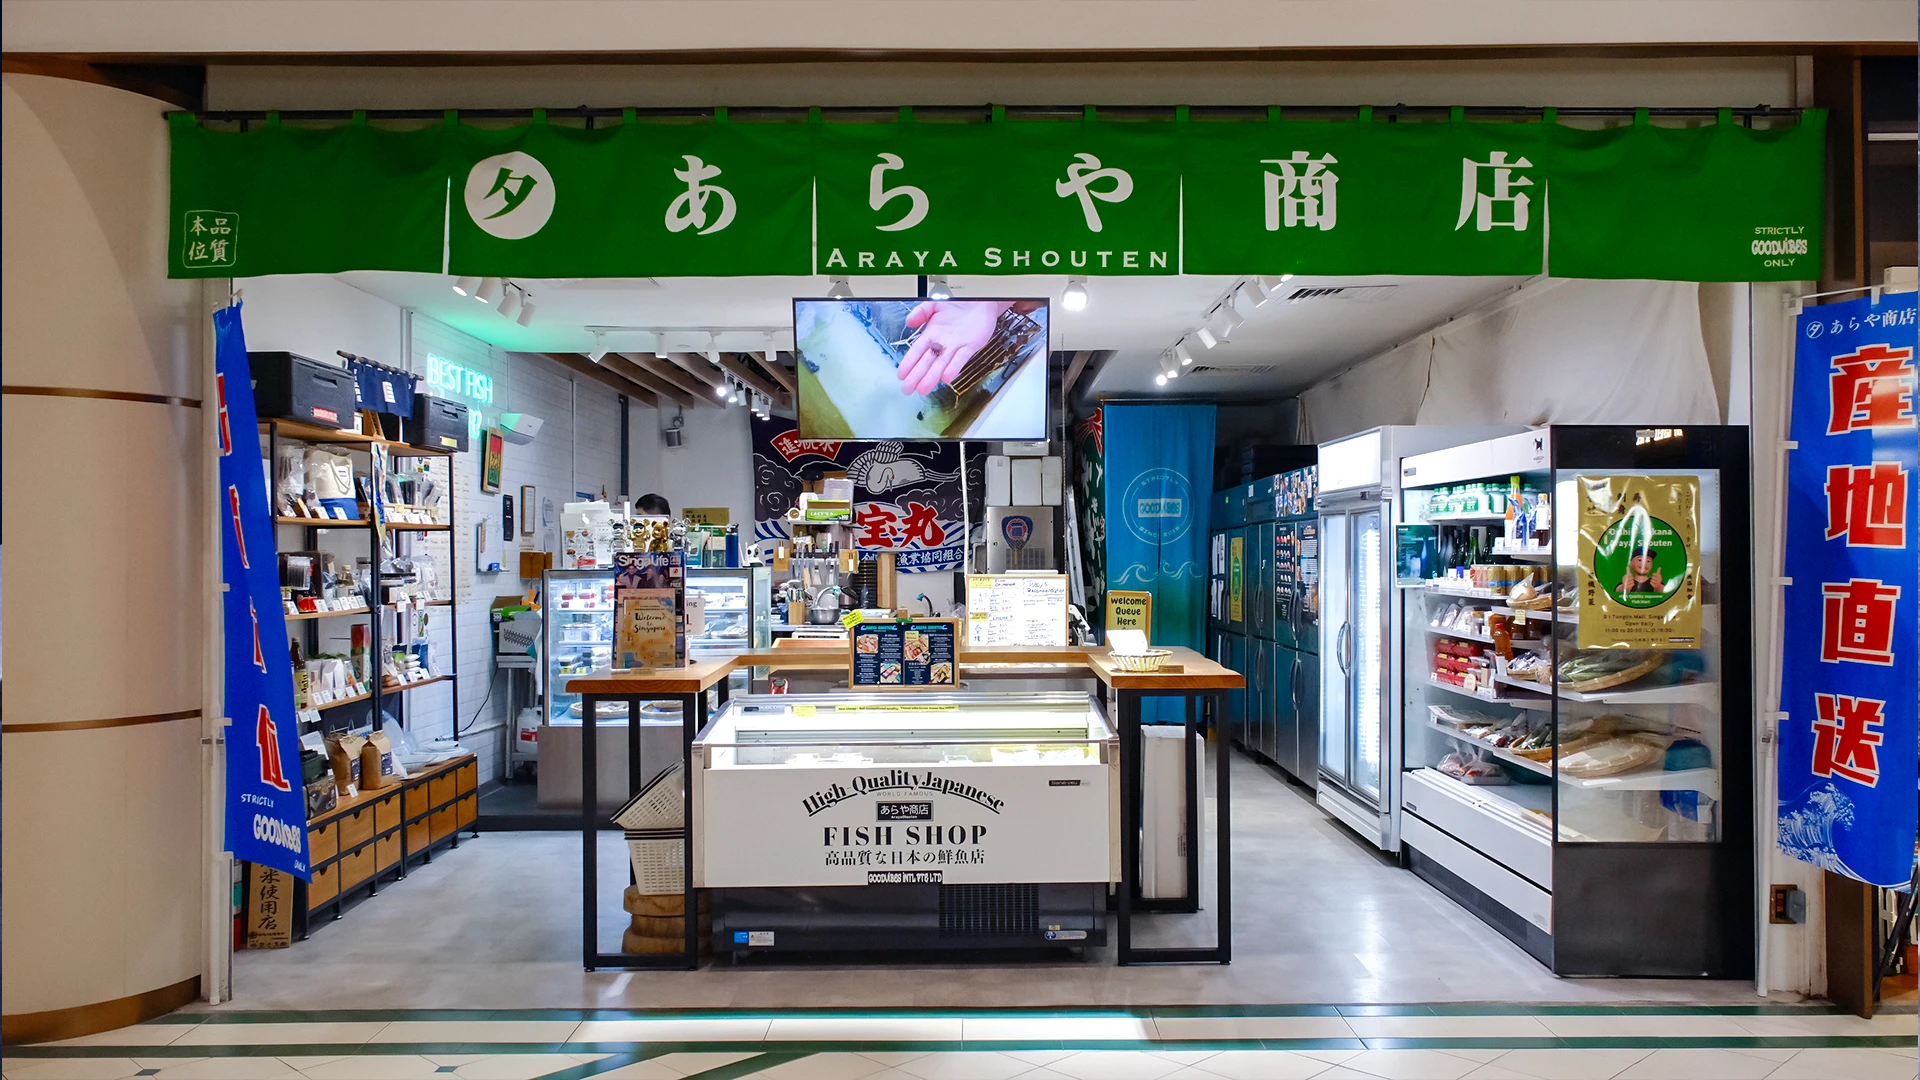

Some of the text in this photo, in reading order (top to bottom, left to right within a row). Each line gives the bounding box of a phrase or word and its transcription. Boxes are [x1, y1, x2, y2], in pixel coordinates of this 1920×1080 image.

[665, 150, 1534, 235] あらや商店
[1755, 226, 1804, 235] STRICTLY
[826, 247, 1168, 269] ARAYA SHOUTEN
[1764, 259, 1795, 267] ONLY
[1830, 308, 1917, 335] あらや商店
[427, 354, 464, 394] BEST
[465, 368, 493, 406] FISH
[857, 503, 945, 548] 宝丸
[1638, 539, 1673, 547] Souten
[1811, 343, 1917, 789] 産地直送
[1115, 606, 1141, 615] Queue
[1117, 617, 1137, 625] Here
[880, 803, 929, 816] あらや商店
[823, 825, 987, 846] FISH SHOP
[825, 849, 985, 866] 高品質な日本の鮮魚店
[258, 864, 280, 930] 米使用店
